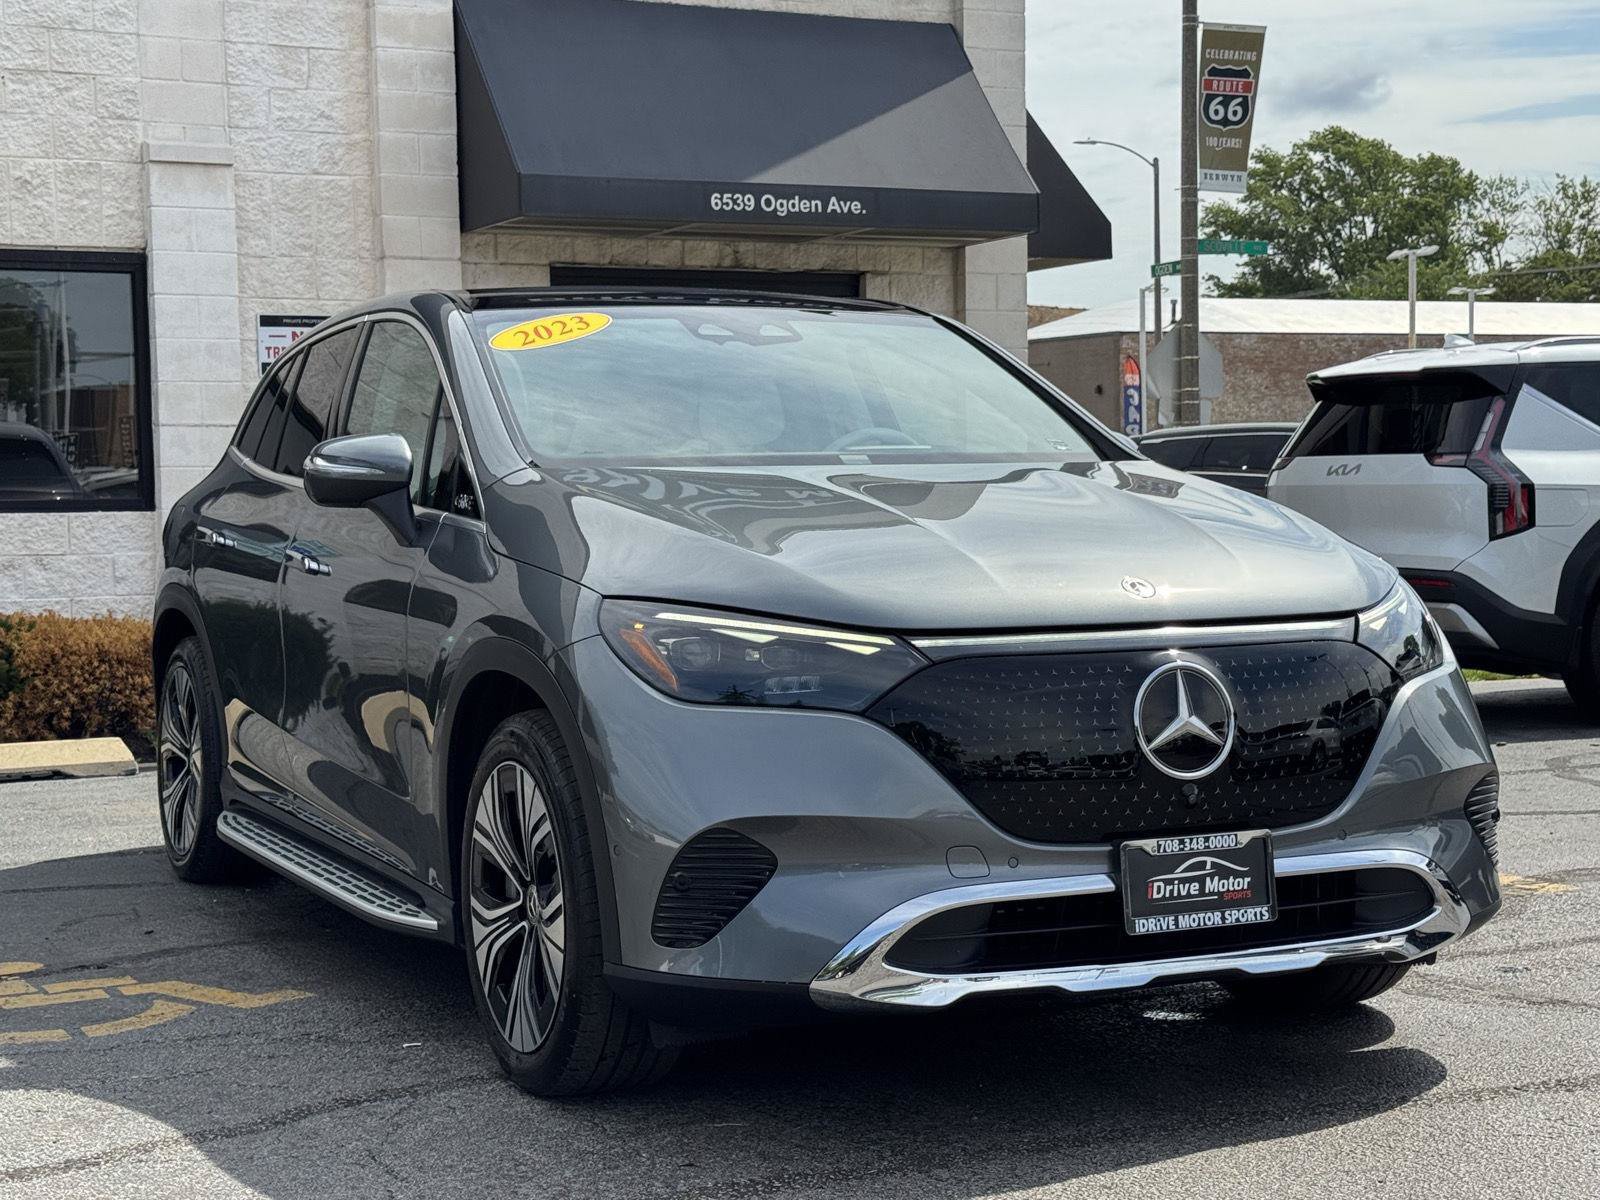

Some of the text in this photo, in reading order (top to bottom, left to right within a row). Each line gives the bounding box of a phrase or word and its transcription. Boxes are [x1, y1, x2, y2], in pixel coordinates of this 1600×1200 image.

[1205, 48, 1257, 62] CELEBRATING
[1212, 79, 1244, 93] ROUTE
[1208, 96, 1244, 122] 66
[1205, 136, 1218, 147] 100
[1203, 172, 1243, 183] BERWYN
[710, 193, 867, 217] 6539 Ogden Ave.
[513, 315, 590, 346] 2023
[1158, 835, 1236, 852] 708-348-0000
[1147, 875, 1251, 900] iDrive Motor
[1222, 890, 1252, 900] SPORTS
[1178, 911, 1223, 929] MOTOR
[1225, 906, 1269, 924] SPORTS
